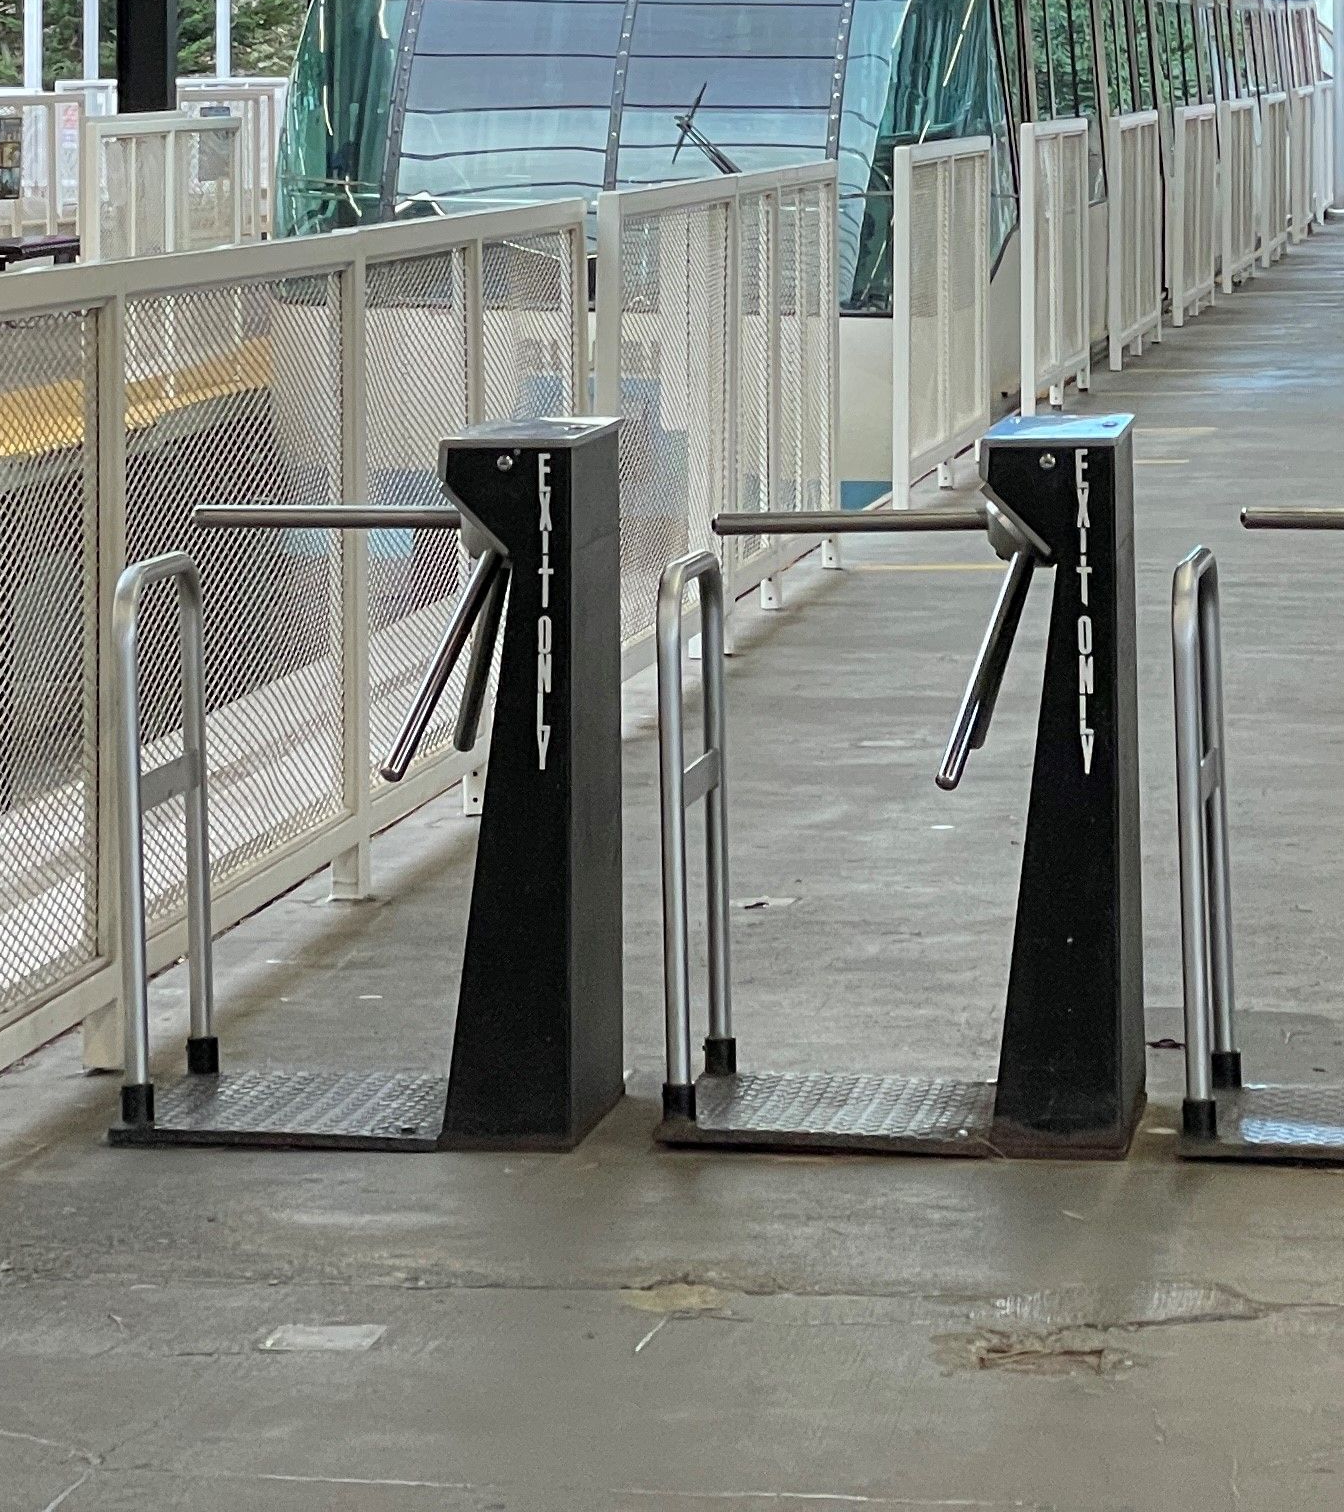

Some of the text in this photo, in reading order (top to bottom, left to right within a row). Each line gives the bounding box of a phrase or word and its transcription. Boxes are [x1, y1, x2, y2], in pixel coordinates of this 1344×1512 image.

[536, 453, 554, 771] EXIT ONLY
[1075, 449, 1095, 775] EXIT ONLY
